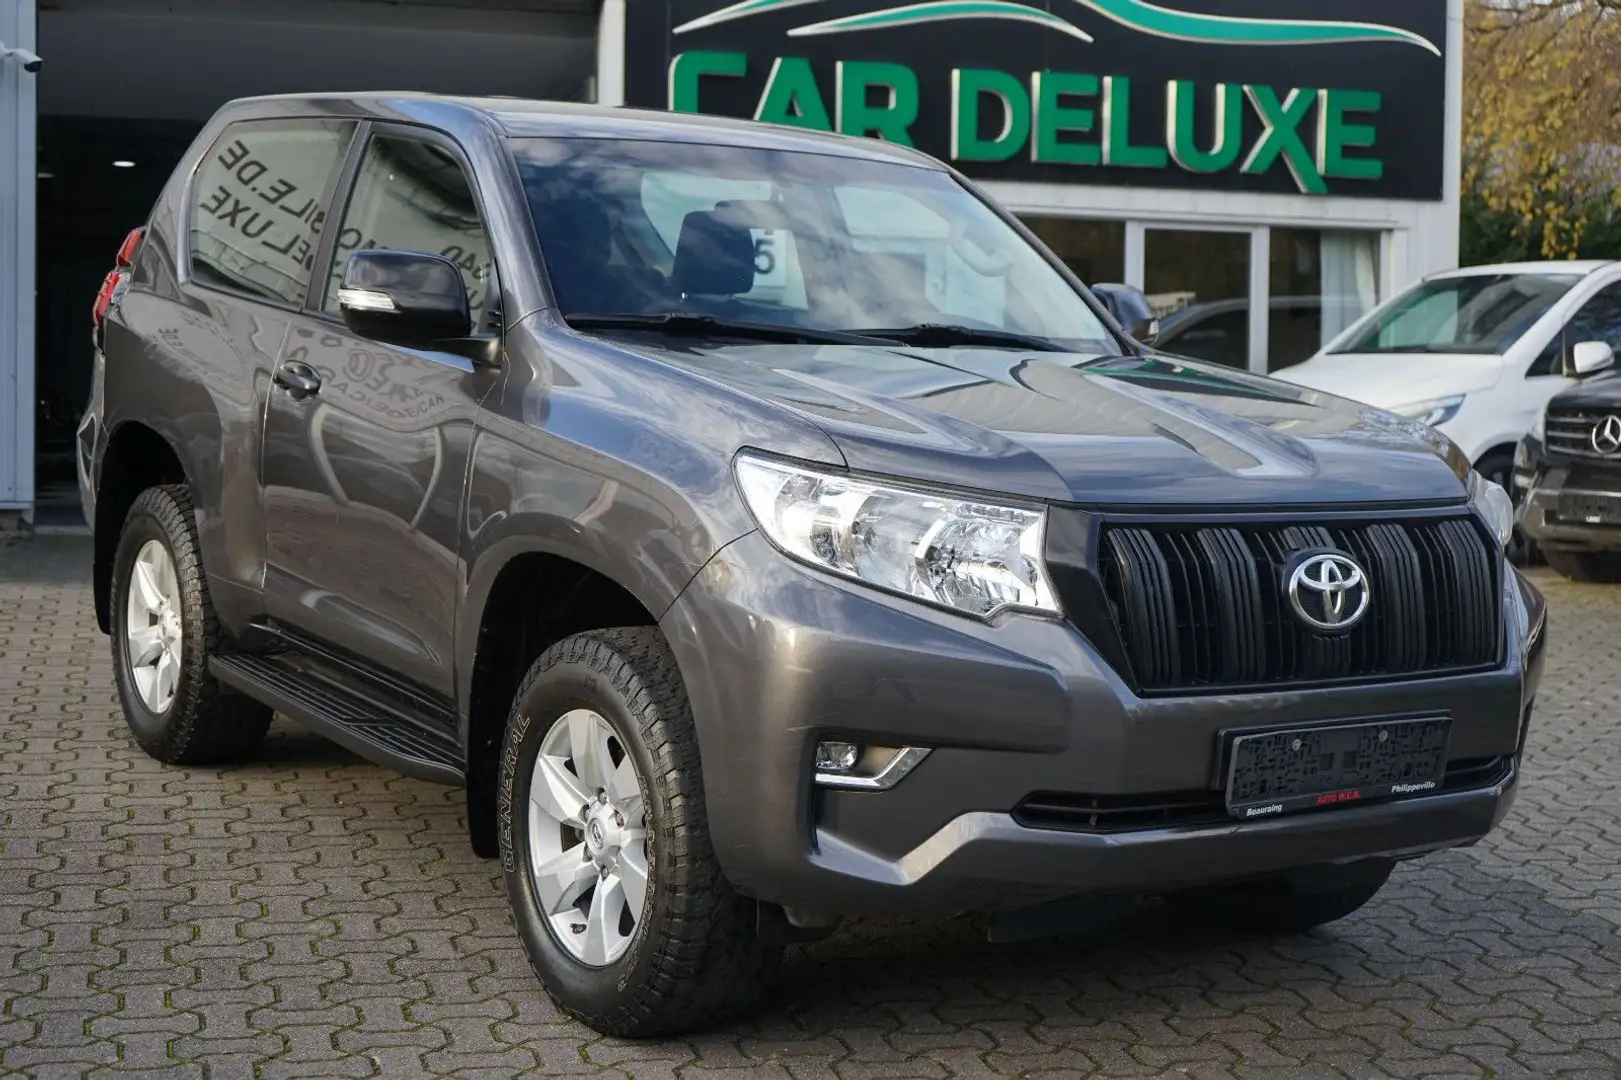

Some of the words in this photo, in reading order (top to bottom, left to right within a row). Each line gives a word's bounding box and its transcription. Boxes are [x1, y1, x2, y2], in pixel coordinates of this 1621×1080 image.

[668, 50, 919, 148] CAR
[951, 68, 1383, 193] DELUXE
[499, 714, 531, 873] GENERAL
[1246, 804, 1283, 816] Beauraing
[1391, 781, 1435, 793] Philippeville
